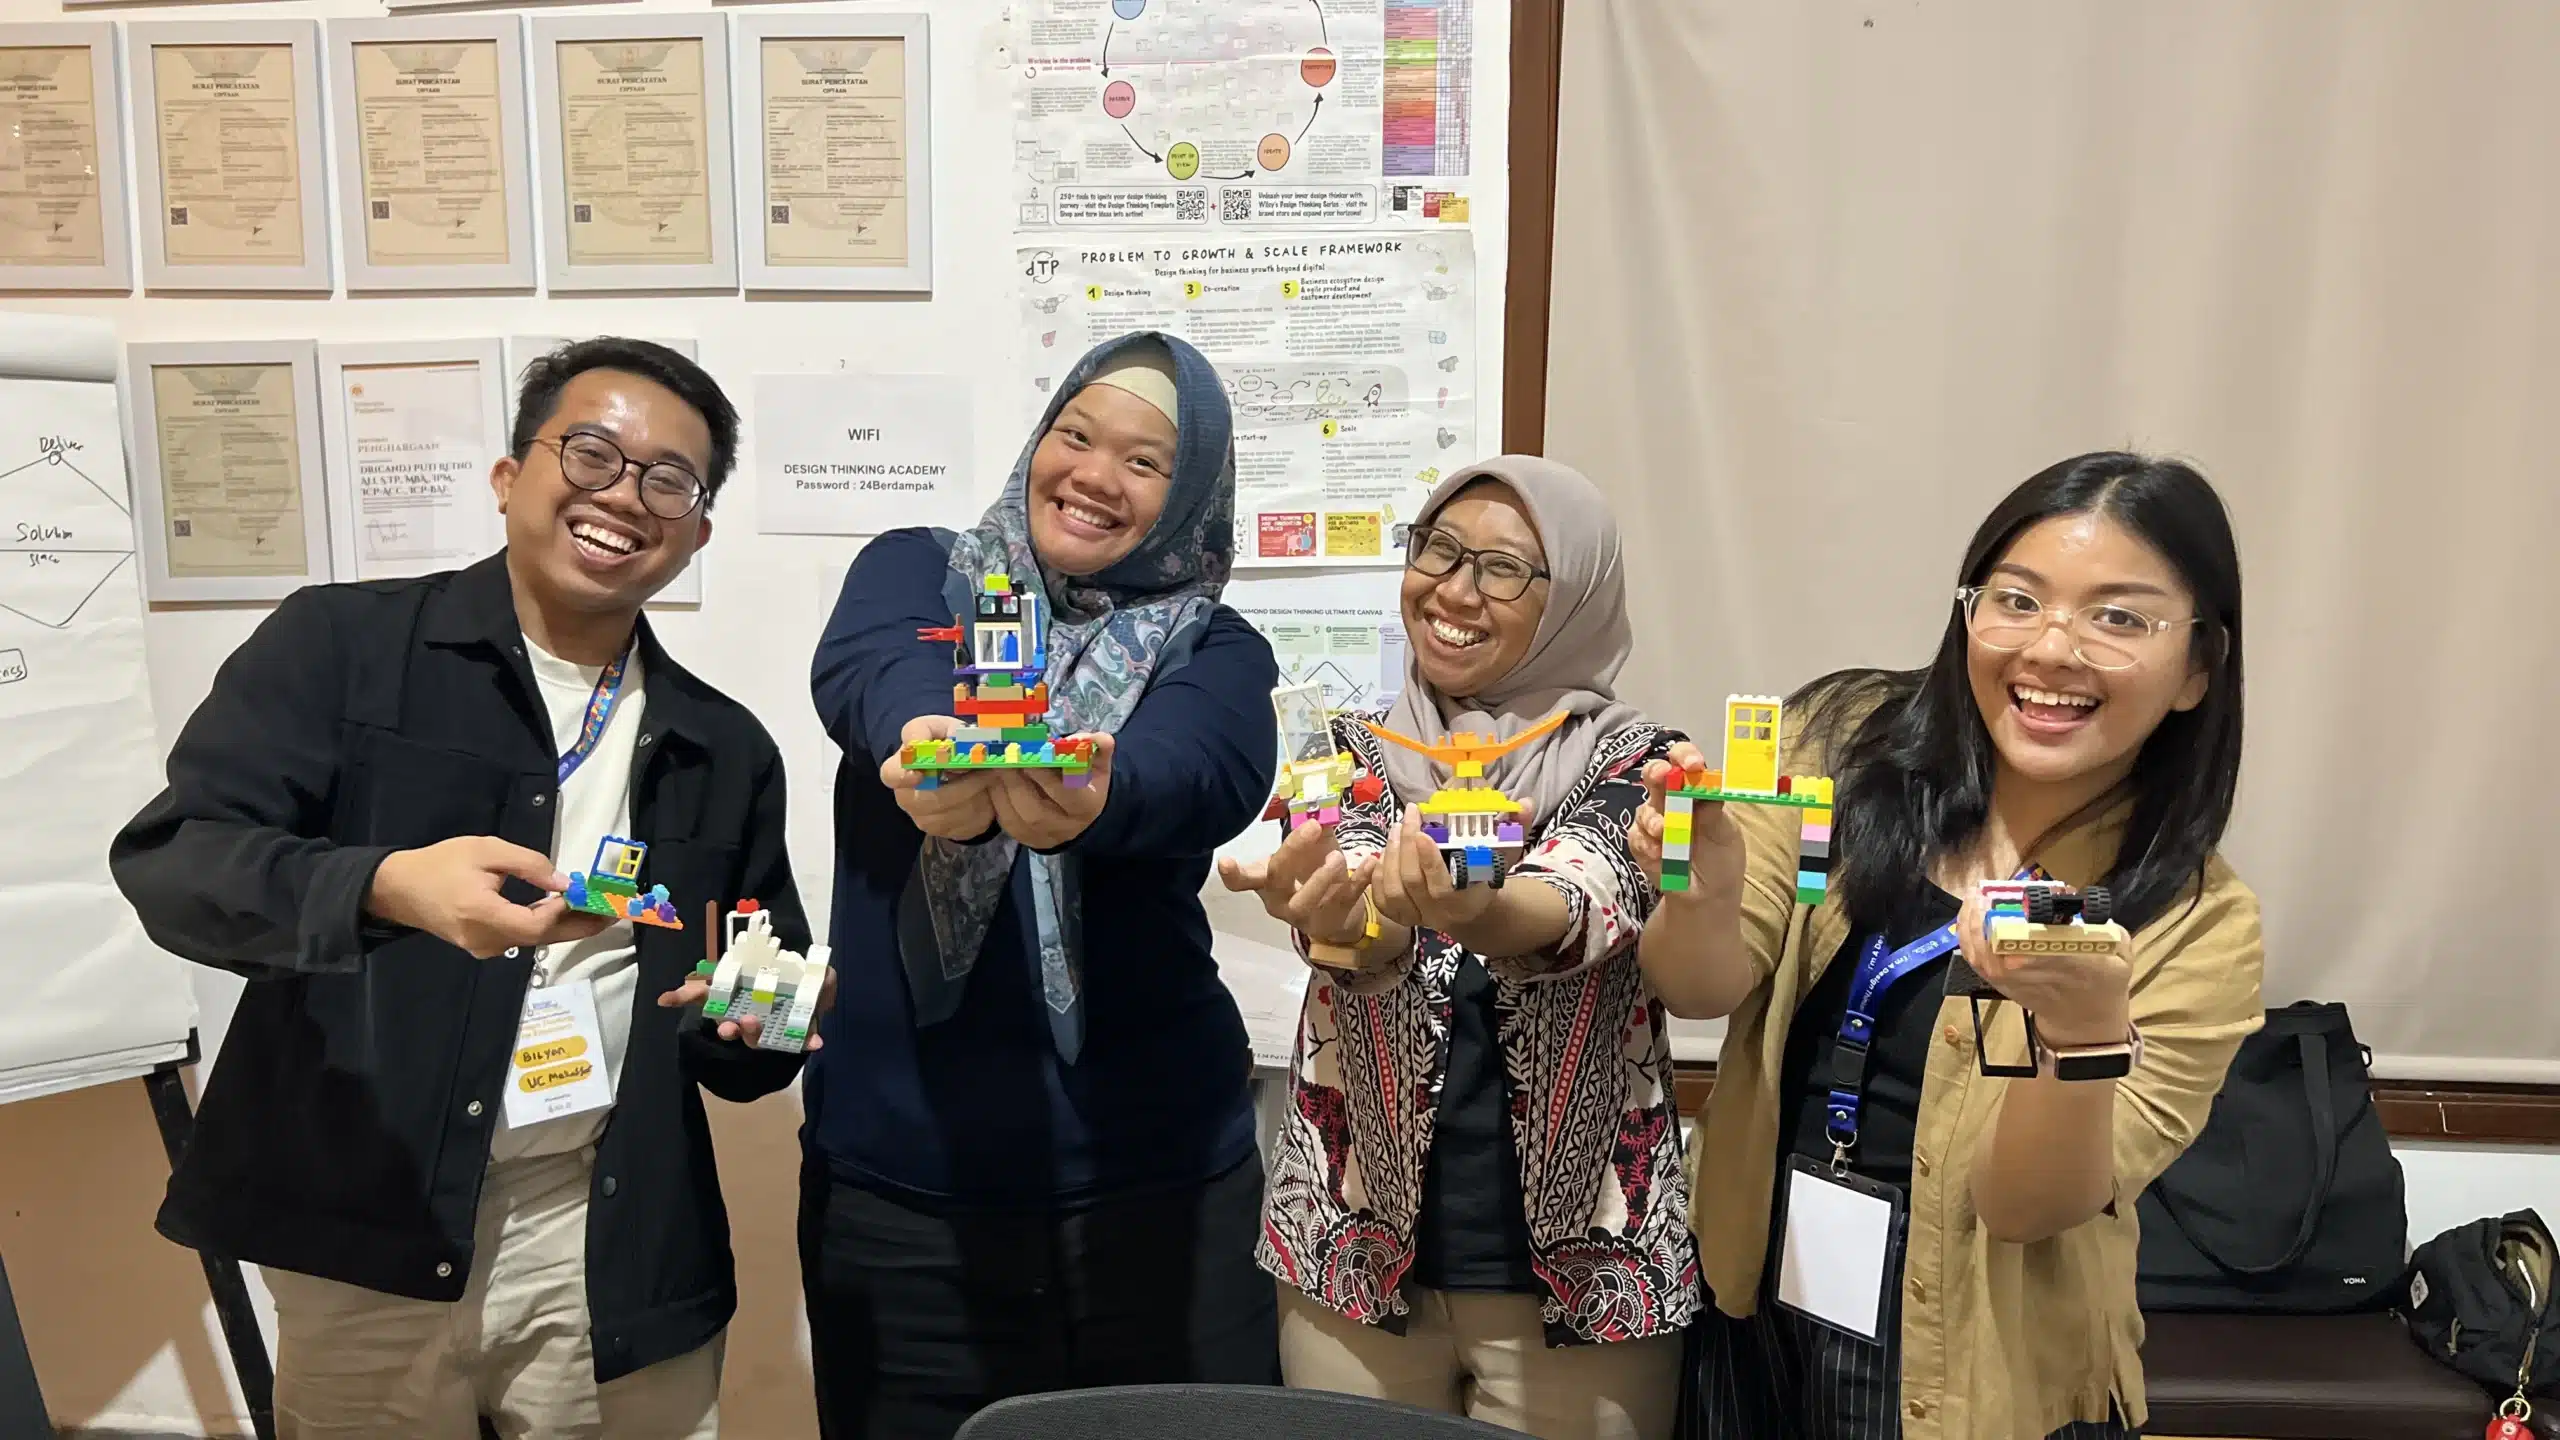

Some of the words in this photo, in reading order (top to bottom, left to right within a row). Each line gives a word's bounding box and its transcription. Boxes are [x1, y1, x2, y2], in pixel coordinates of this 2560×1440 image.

[1081, 252, 1145, 263] PROBLEM
[1154, 250, 1171, 261] TO
[1182, 248, 1235, 260] GROWTH
[1245, 248, 1254, 259] &
[1264, 246, 1308, 257] SCALE
[1320, 242, 1402, 256] FRAMEWORK
[1155, 268, 1177, 278] Design
[1179, 267, 1207, 276] thinking
[1209, 266, 1219, 275] for
[1221, 266, 1249, 275] business
[1251, 264, 1274, 274] growth
[1276, 263, 1301, 274] beyond
[1302, 263, 1325, 273] digital
[1301, 277, 1328, 285] Business
[1330, 276, 1362, 286] ecosystem
[1364, 275, 1385, 284] design
[1088, 287, 1096, 298] 1
[1104, 289, 1124, 298] Design
[1126, 288, 1151, 298] thinking
[1187, 284, 1194, 295] 3
[1284, 283, 1291, 294] 5
[1307, 286, 1321, 294] agile
[1323, 285, 1347, 293] product
[1301, 293, 1330, 301] customer
[1332, 291, 1372, 300] development
[1323, 423, 1330, 434] 6
[1340, 425, 1357, 433] Scale
[848, 428, 880, 441] WIFI
[784, 464, 827, 474] DESIGN
[831, 464, 885, 475] THINKING
[888, 465, 946, 475] ACADEMY
[796, 480, 850, 490] Password
[859, 480, 935, 492] 24Berdampak
[1868, 967, 1890, 990] Design
[527, 1075, 545, 1089] UC
